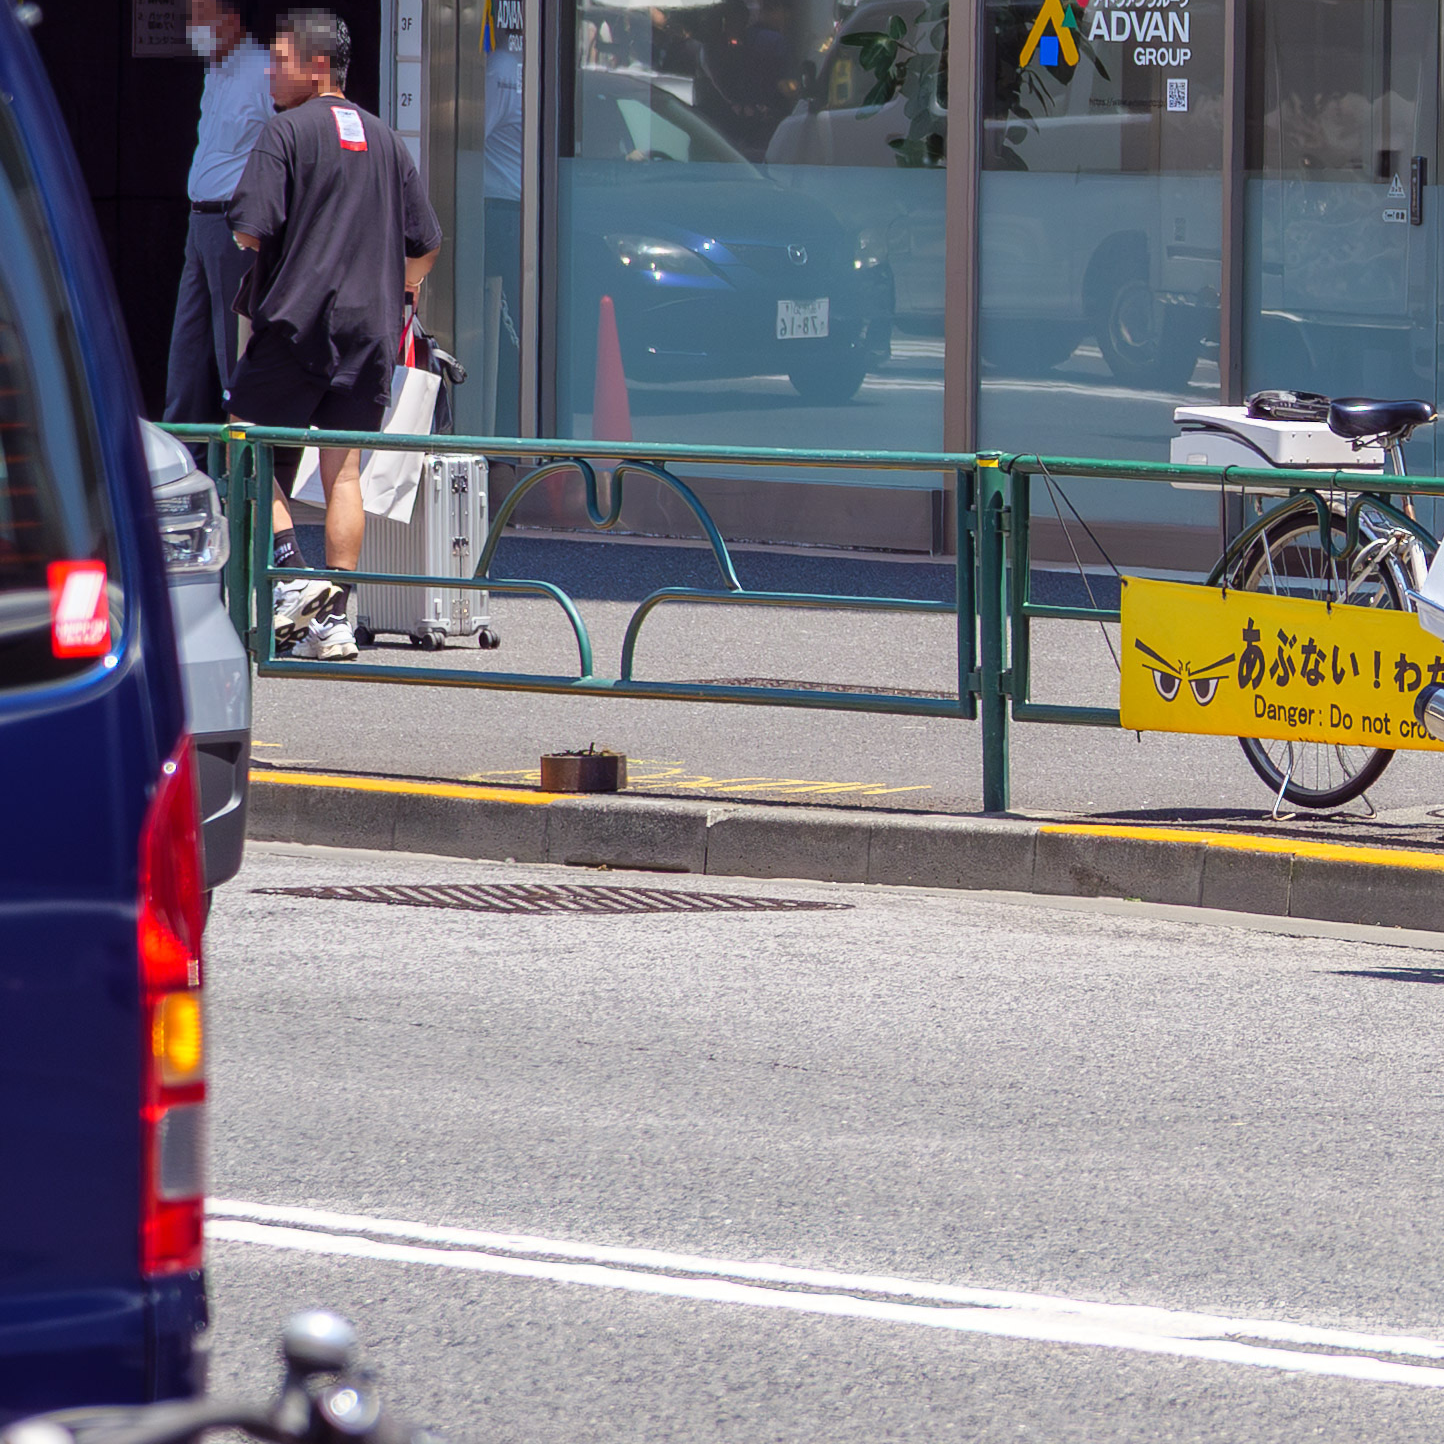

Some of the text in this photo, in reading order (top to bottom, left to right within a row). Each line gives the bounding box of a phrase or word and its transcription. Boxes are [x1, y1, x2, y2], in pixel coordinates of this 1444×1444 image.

[401, 17, 412, 30] 3F
[1088, 11, 1190, 43] ADVAN
[1133, 47, 1192, 66] GROUP
[401, 93, 412, 106] 2F
[1330, 703, 1353, 730] Do
[1362, 713, 1392, 736] not
